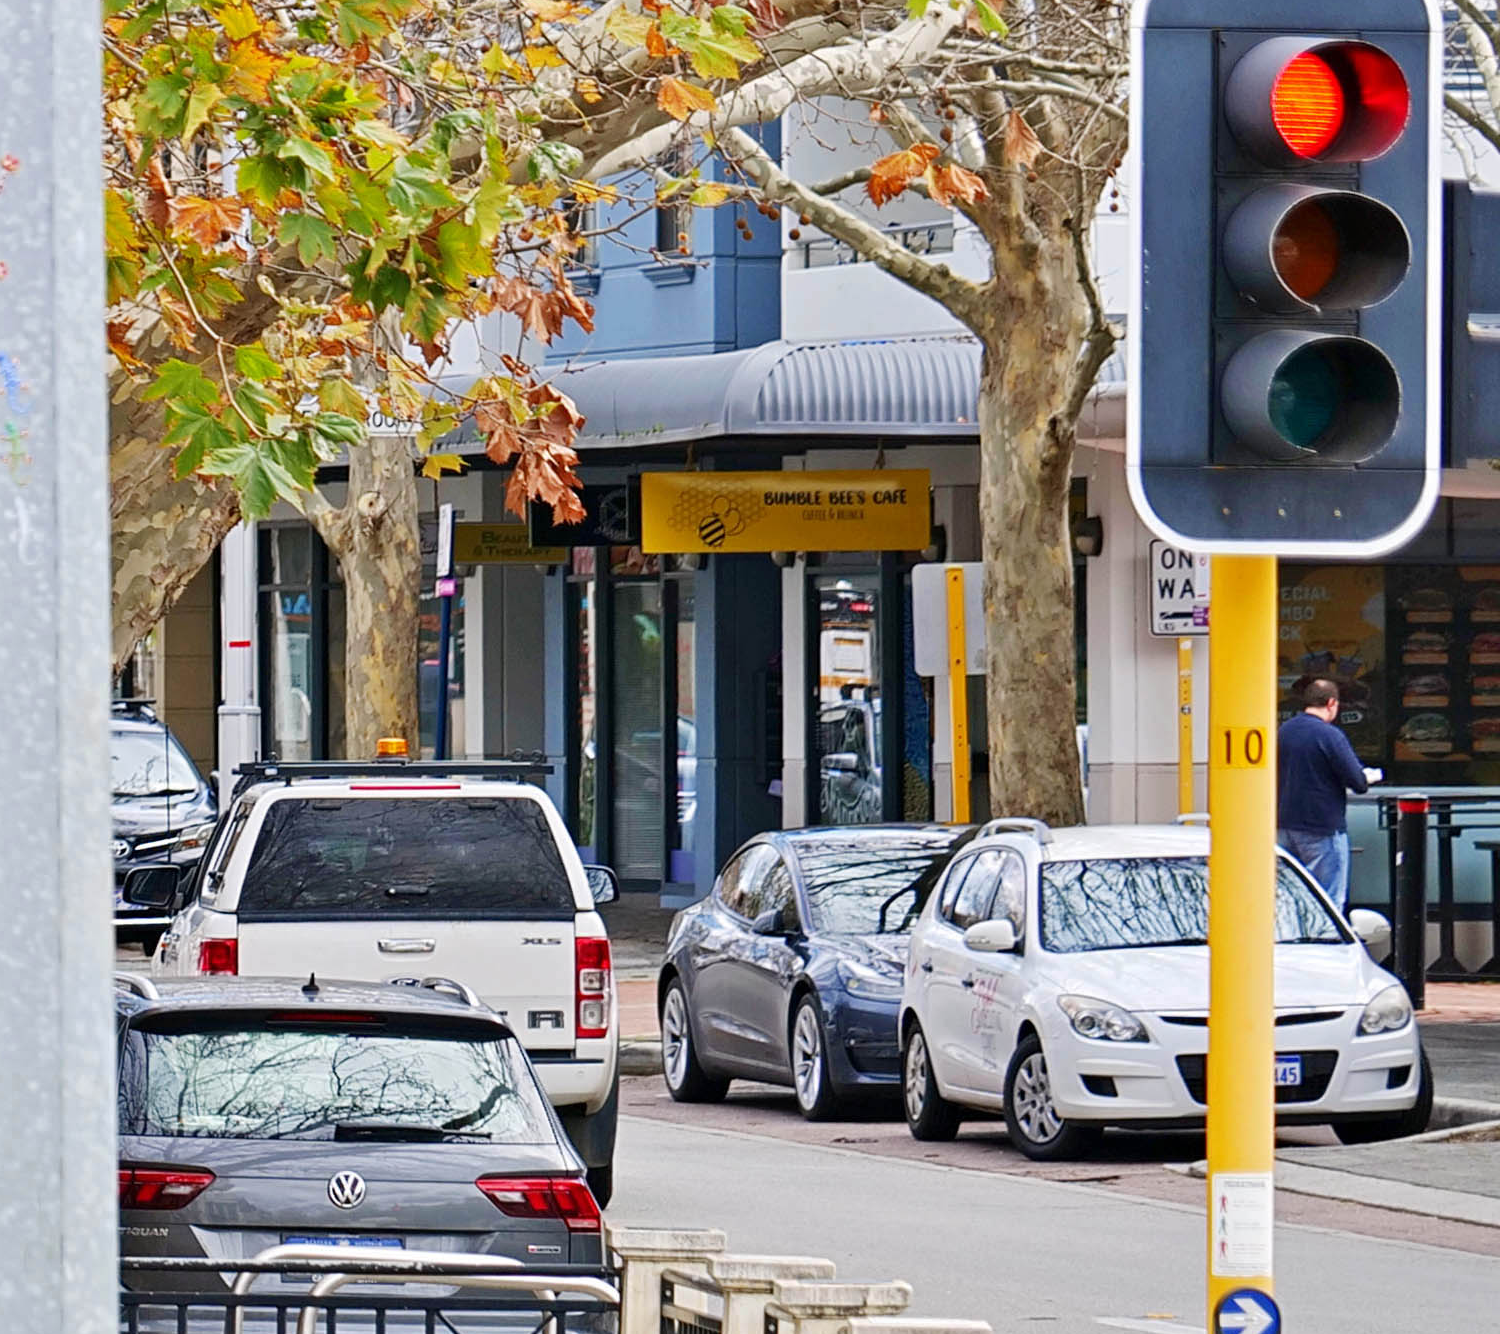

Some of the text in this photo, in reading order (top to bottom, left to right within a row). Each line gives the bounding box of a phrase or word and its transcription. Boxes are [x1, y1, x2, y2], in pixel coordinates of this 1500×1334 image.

[764, 489, 907, 505] BUMBLE BEE'S CAFE
[1161, 548, 1193, 570] ON
[1158, 578, 1196, 600] WA
[1224, 729, 1264, 765] 10
[521, 937, 562, 945] XLS
